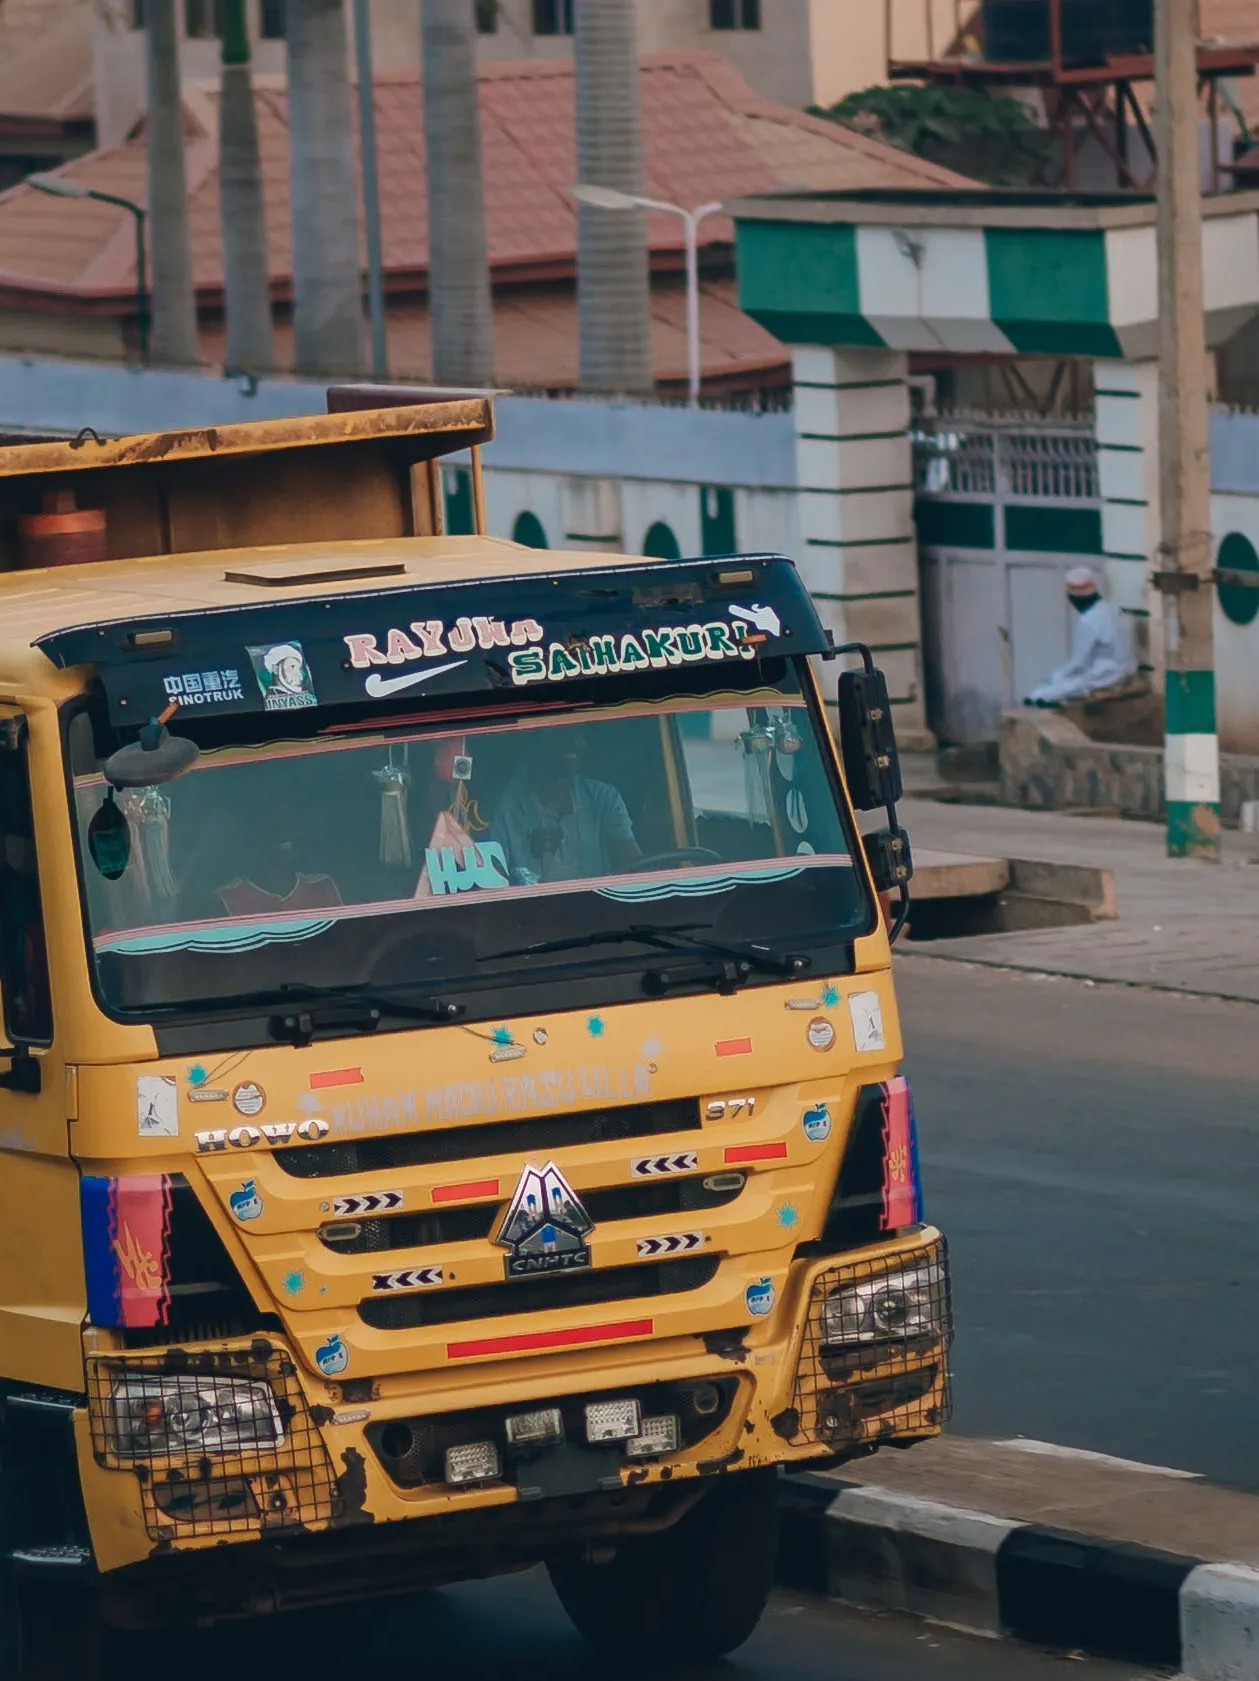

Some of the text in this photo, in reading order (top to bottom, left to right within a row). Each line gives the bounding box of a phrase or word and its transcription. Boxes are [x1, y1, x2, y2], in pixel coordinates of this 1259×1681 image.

[163, 669, 241, 694] 中国重汽
[168, 688, 245, 706] SINOTRUK
[194, 1119, 330, 1152] HOWO
[512, 1251, 587, 1271] CNHTC
